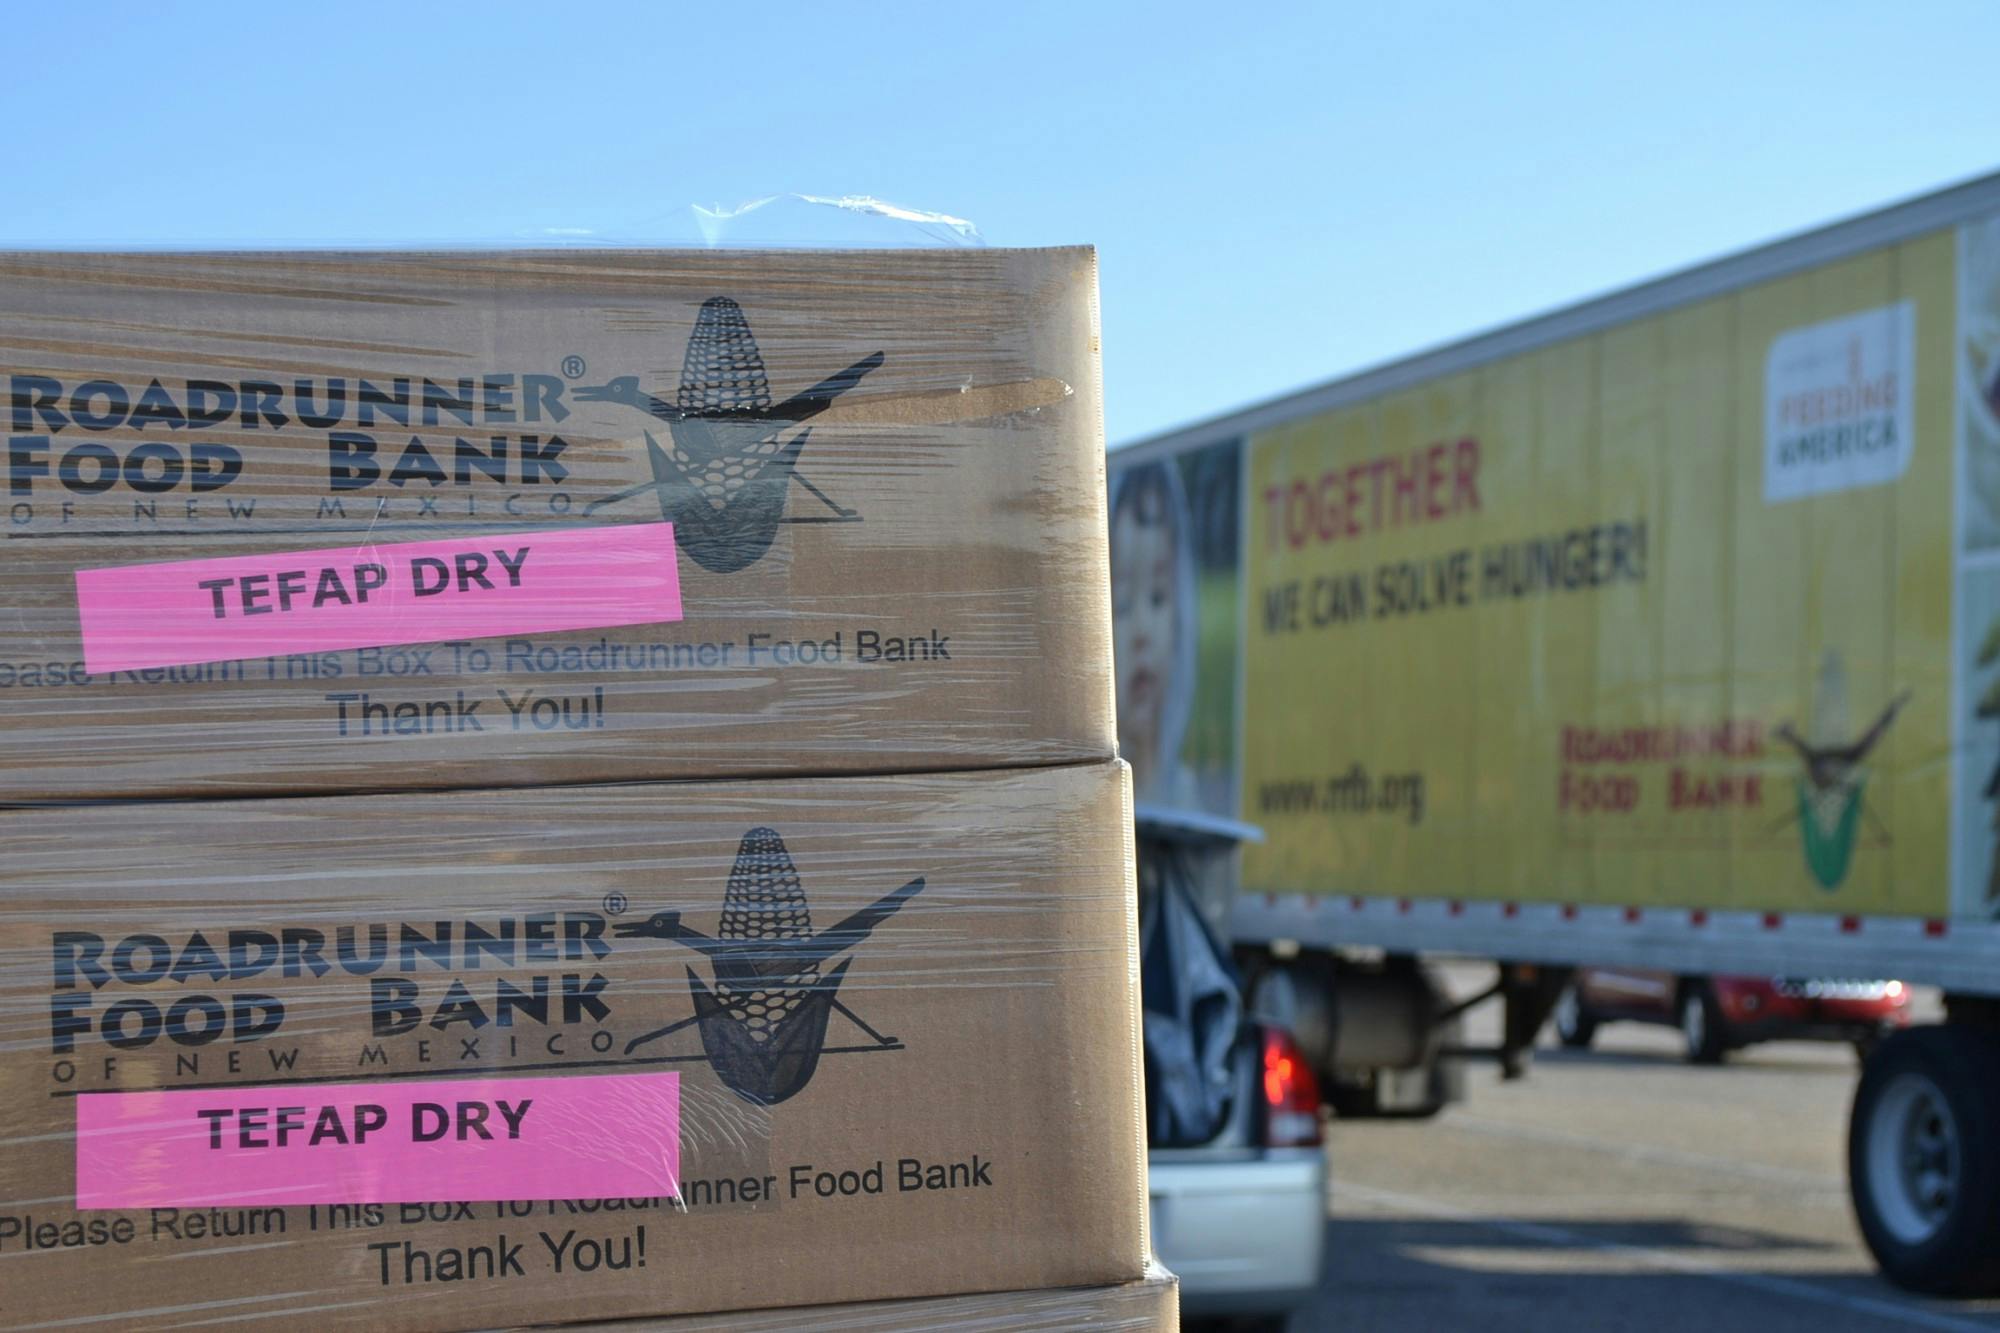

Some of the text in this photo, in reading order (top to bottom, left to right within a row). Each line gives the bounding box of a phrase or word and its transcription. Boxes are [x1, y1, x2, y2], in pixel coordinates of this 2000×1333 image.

[10, 373, 571, 434] ROADRUNNER
[9, 431, 571, 496] FOOD BANK
[1777, 415, 1899, 467] AMERICA
[10, 492, 571, 525] OF NEW MEXICO
[1265, 437, 1480, 553] TOGETHER
[199, 547, 531, 619] TEFAP DRY
[1263, 518, 1649, 634] WE CAN SOLVE HUNGER!
[357, 646, 432, 675] Box
[444, 641, 491, 674] To
[507, 635, 734, 672] Roadrunner
[748, 632, 842, 665] Food
[857, 629, 951, 662] Bank
[326, 687, 604, 737] Thank You!
[52, 912, 612, 990] ROADRUNNER
[51, 972, 612, 1054] FOOD BANK
[53, 1031, 613, 1083] OF NEW MEXICO
[198, 1099, 532, 1150] TEFAP DRY
[0, 1215, 135, 1250] Please
[151, 1206, 286, 1241] Return
[790, 1163, 884, 1199] Food
[898, 1154, 993, 1192] Bank
[367, 1225, 646, 1287] Thank You!
